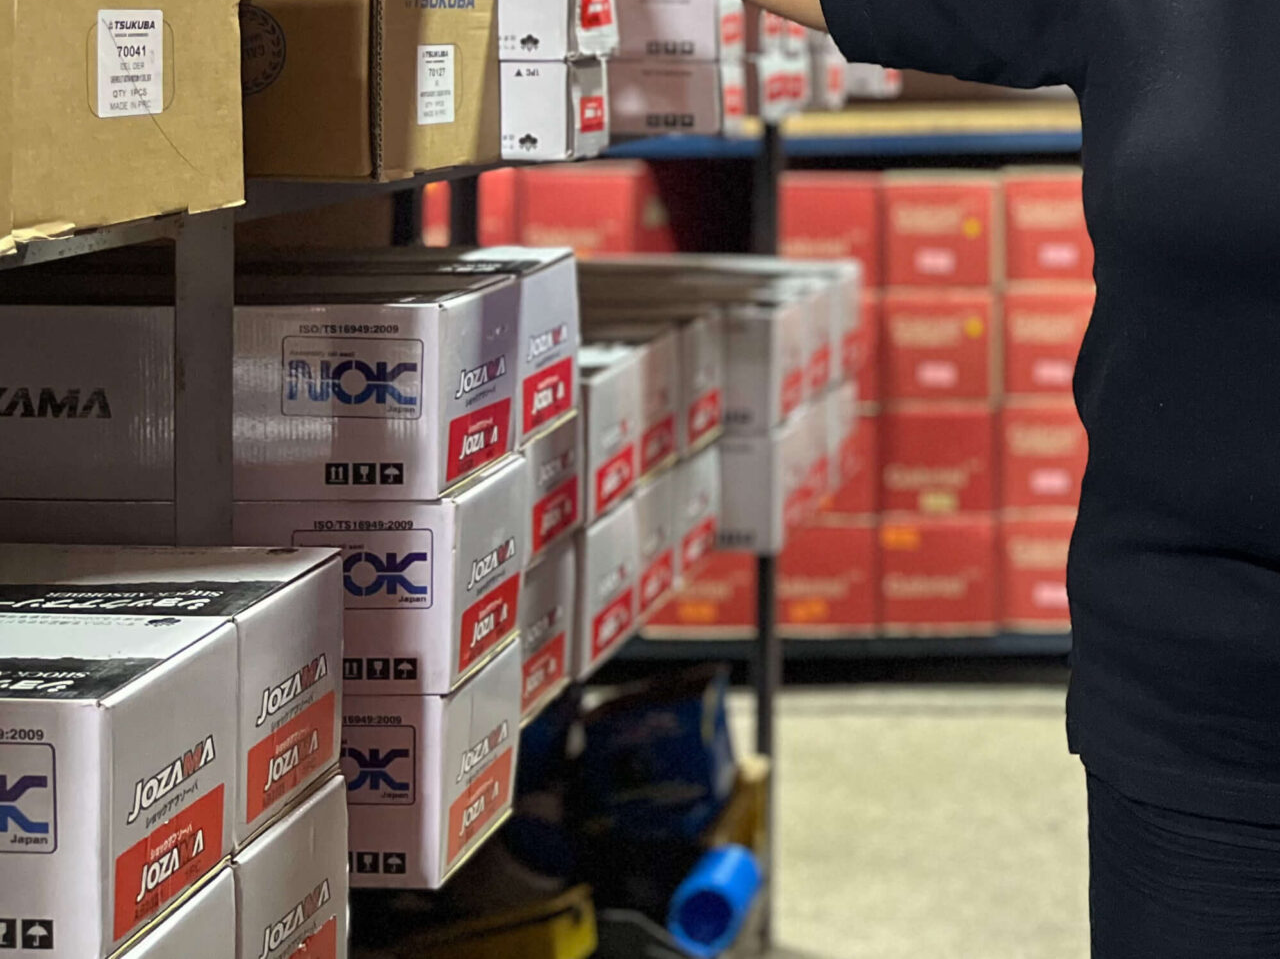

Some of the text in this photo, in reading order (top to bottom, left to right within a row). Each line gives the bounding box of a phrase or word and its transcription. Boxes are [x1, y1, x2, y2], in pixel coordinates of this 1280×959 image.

[114, 20, 156, 30] TSUKUBA
[117, 45, 147, 58] 70041
[286, 359, 418, 406] NOK
[459, 424, 498, 461] JOZAA
[343, 551, 428, 597] OK
[398, 595, 427, 604] Japan
[470, 602, 508, 648] JOZAA
[126, 734, 215, 826] JOZAMA
[341, 747, 410, 791] OK
[459, 780, 499, 837] JOZAA
[10, 834, 48, 846] Japan
[258, 877, 331, 959] JOZAMA
